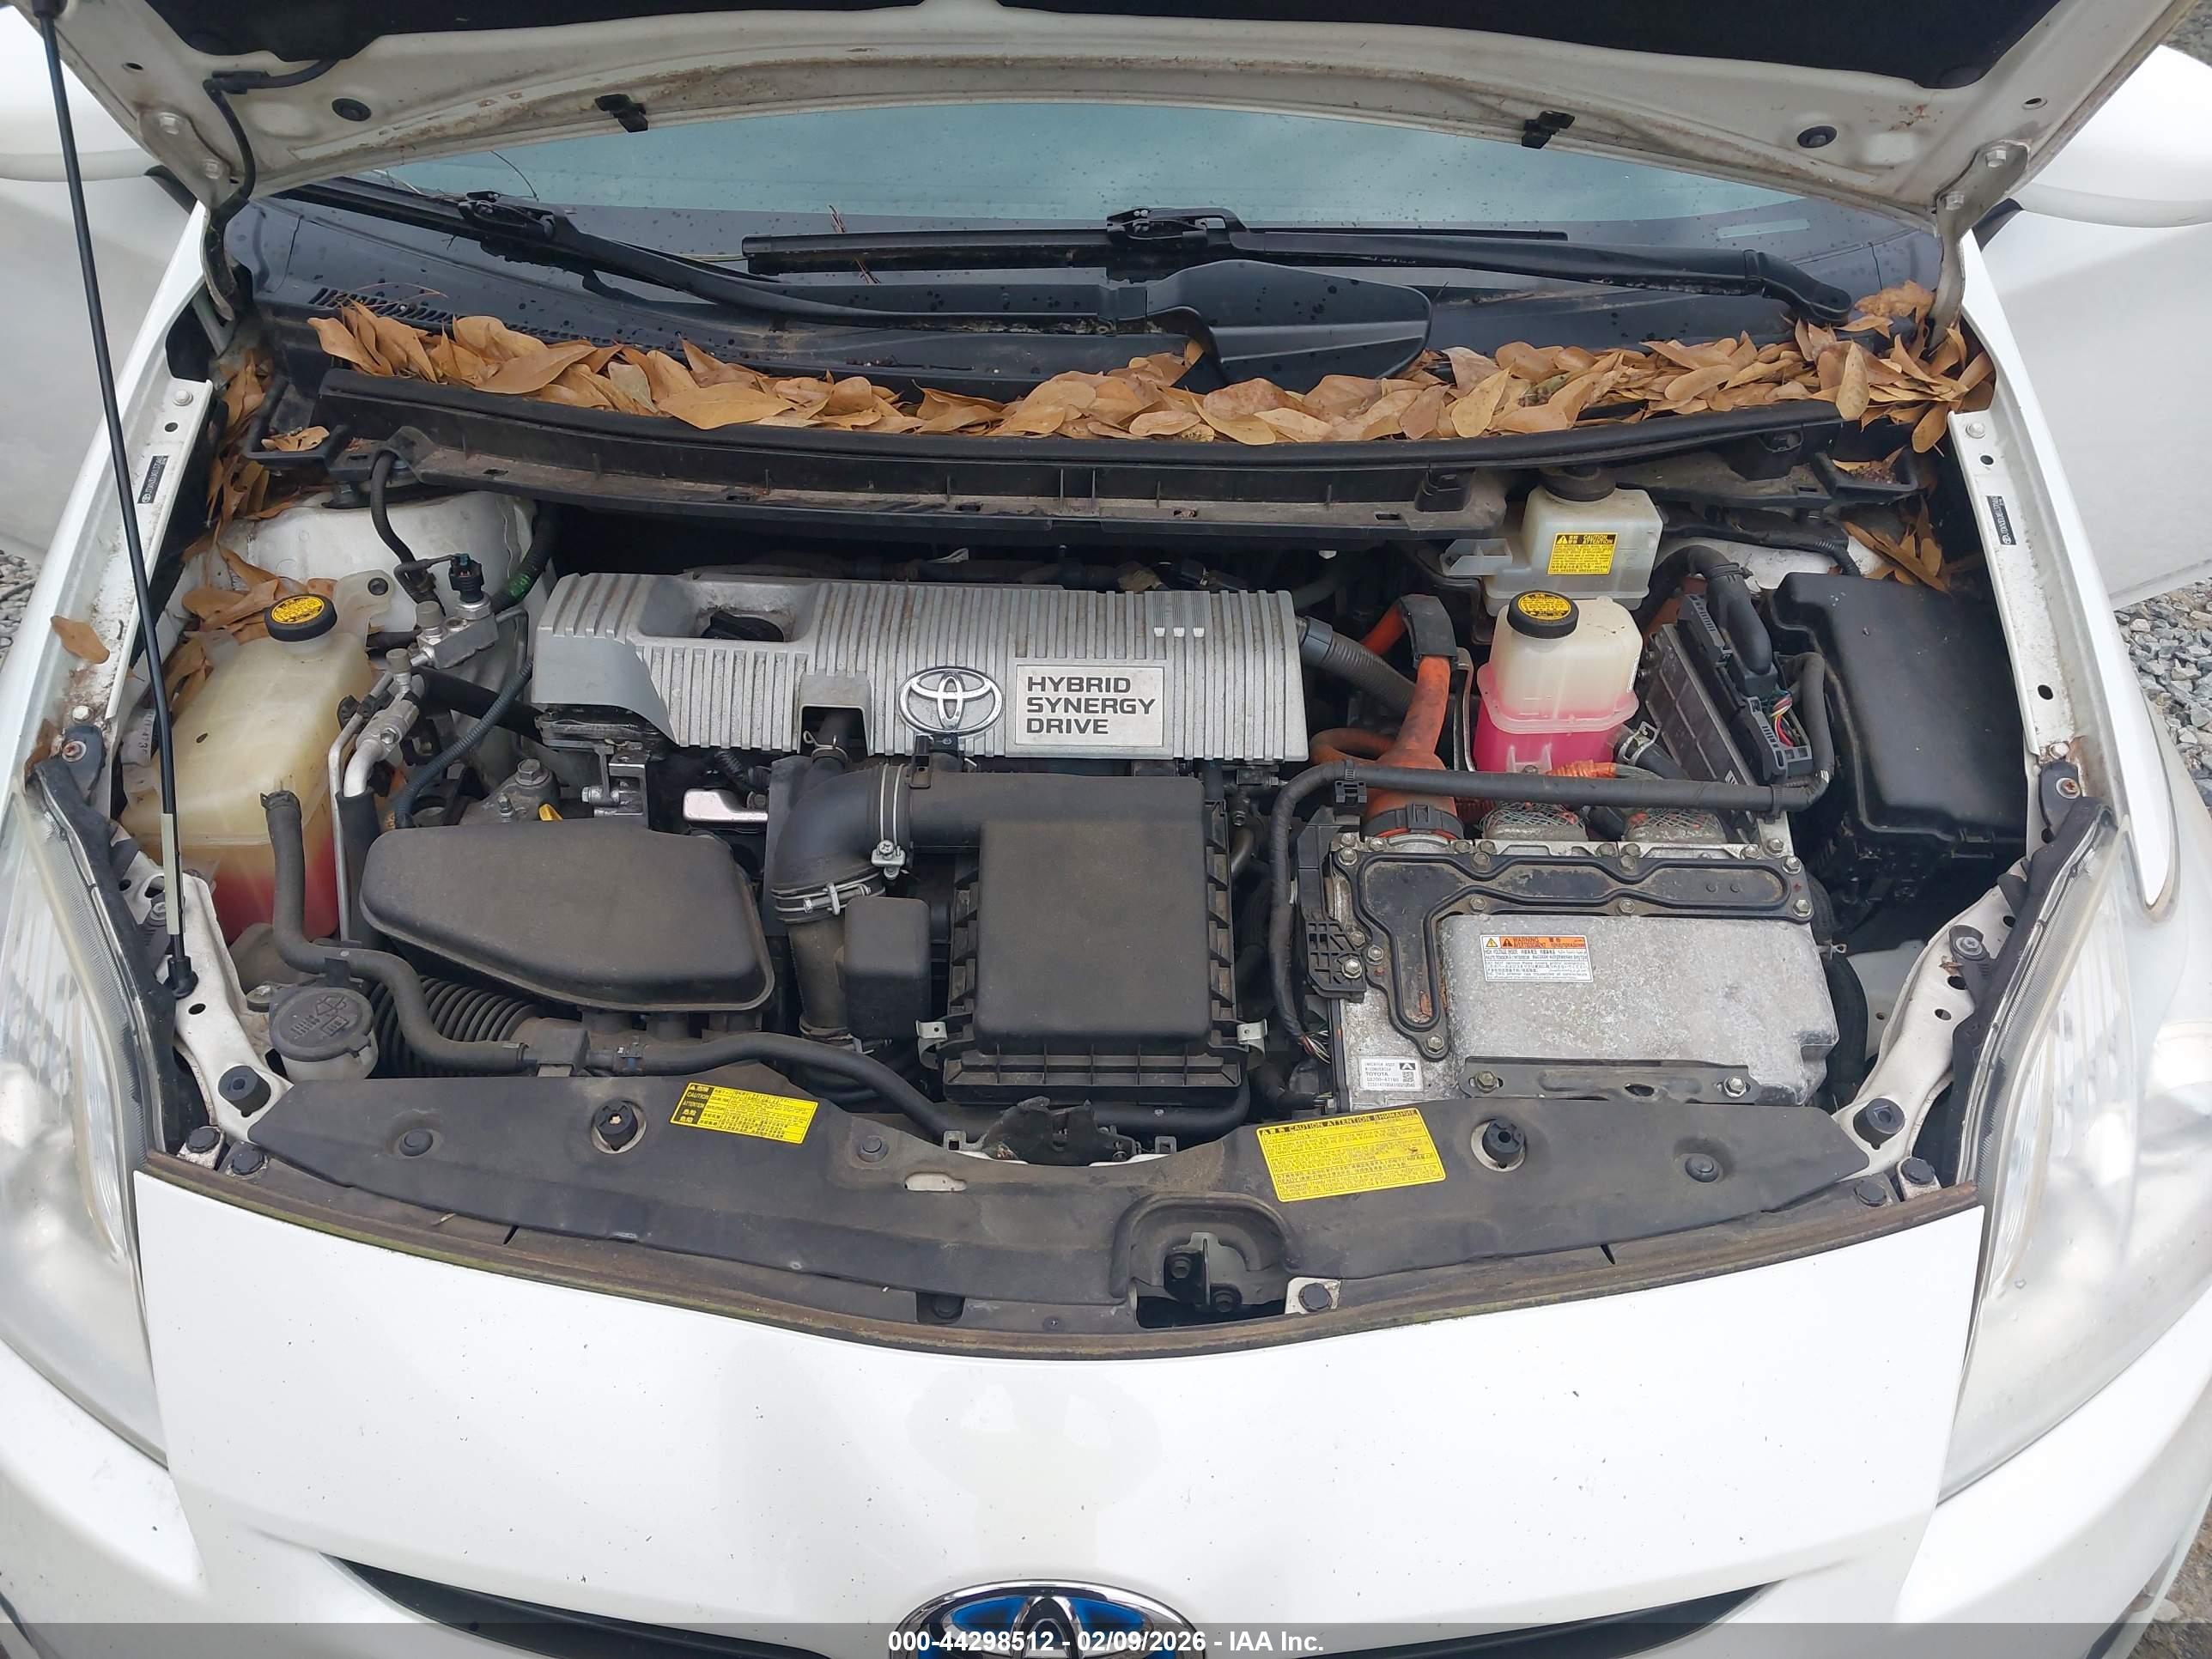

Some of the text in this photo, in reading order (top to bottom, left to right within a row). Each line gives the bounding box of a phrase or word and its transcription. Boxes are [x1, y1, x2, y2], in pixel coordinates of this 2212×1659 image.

[1027, 676, 1131, 693] HYBRID
[1026, 696, 1156, 714] SYNERGY
[1026, 718, 1109, 734] DRIVE
[687, 1091, 710, 1100] CAUTION
[682, 1100, 705, 1109] ATTENTION
[1288, 1121, 1323, 1132] CAUTION
[1327, 1115, 1370, 1127] ATTENTION
